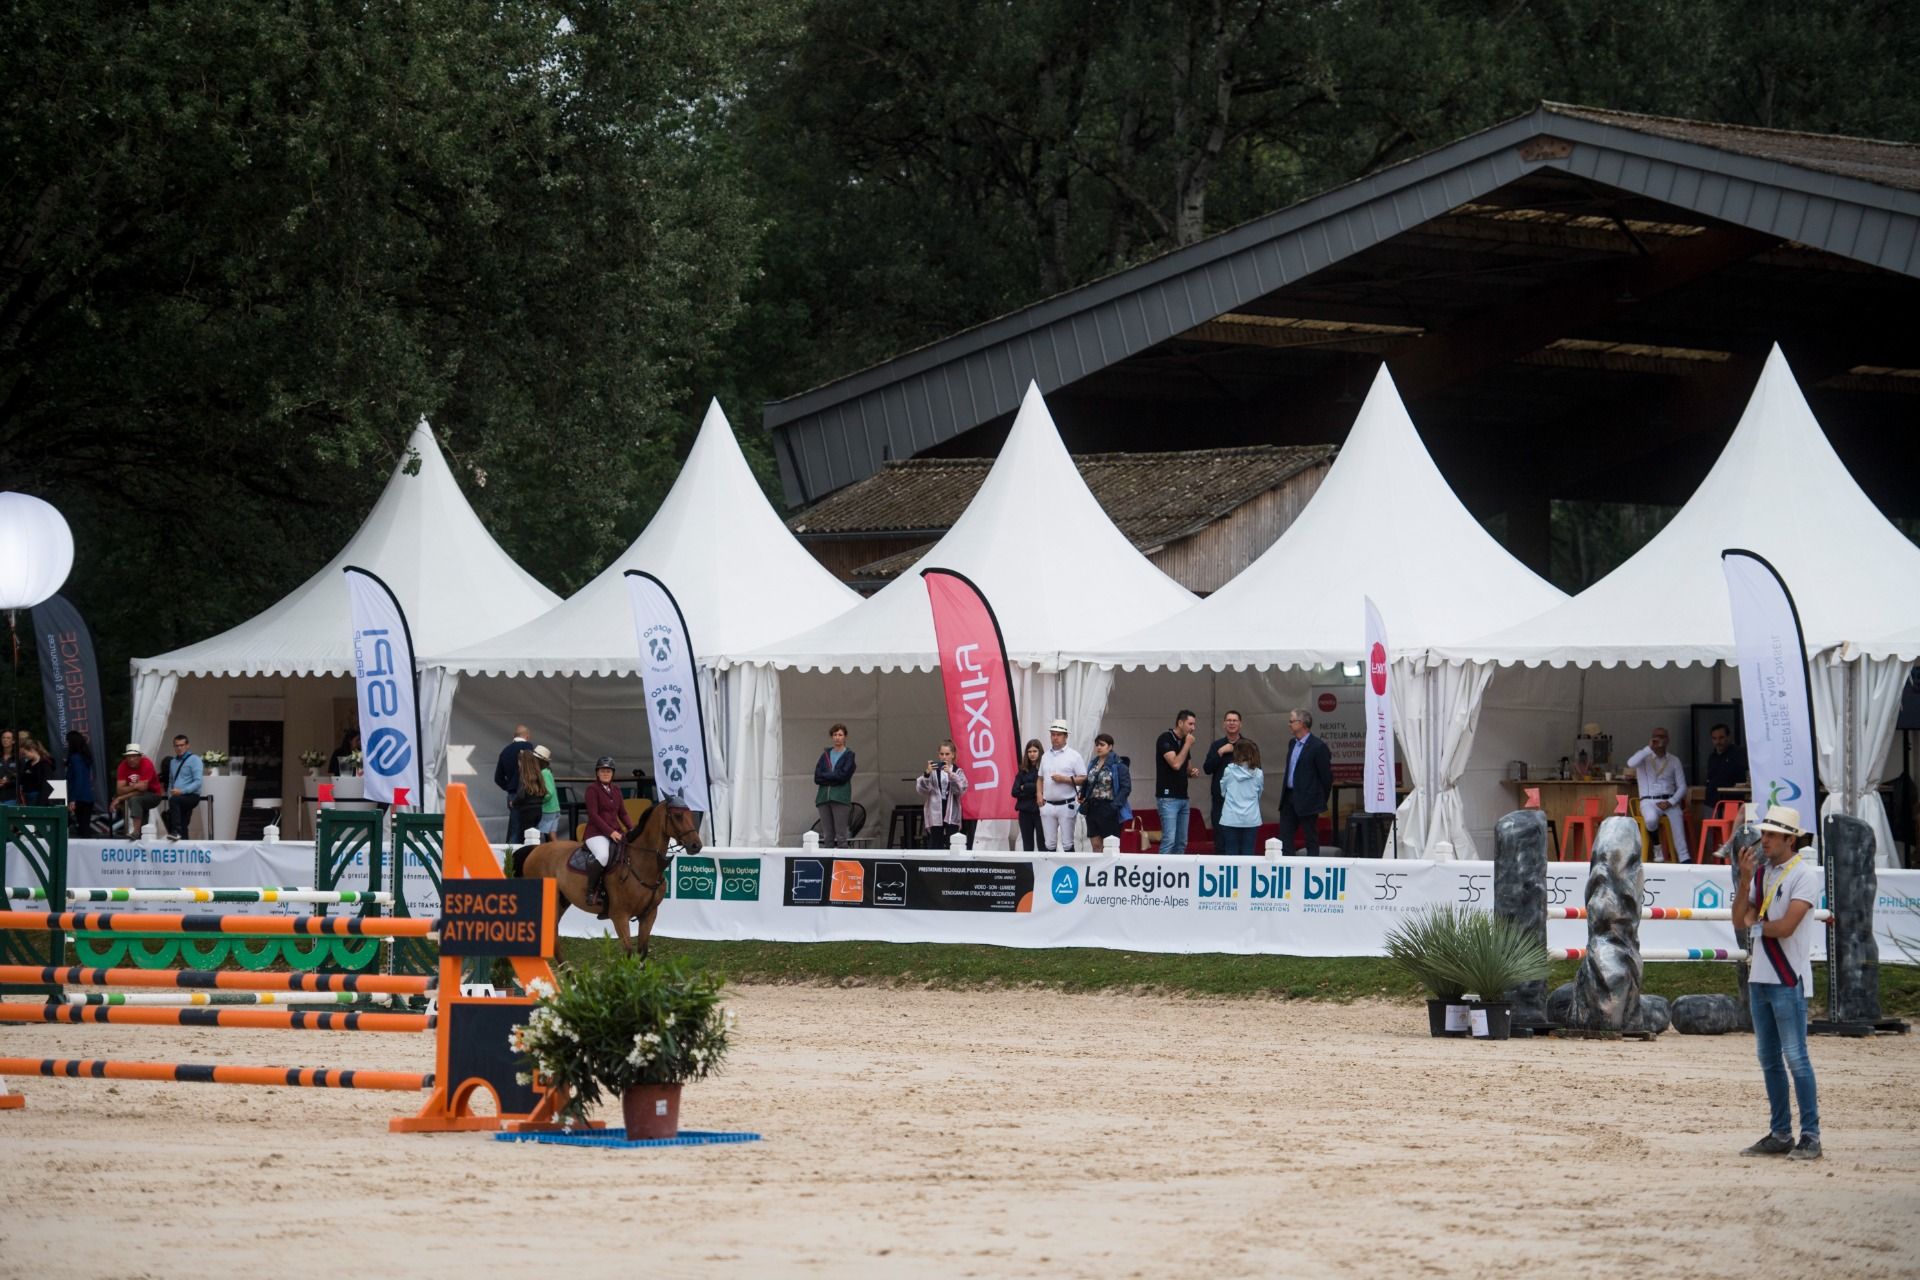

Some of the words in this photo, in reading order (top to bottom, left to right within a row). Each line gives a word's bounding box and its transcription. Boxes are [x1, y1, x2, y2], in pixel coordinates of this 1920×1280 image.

[101, 848, 147, 863] GROUPE
[151, 849, 211, 864] MEETINGS
[692, 866, 715, 874] Optique
[736, 867, 759, 875] Optique
[1085, 865, 1109, 888] La
[1114, 865, 1190, 893] Région
[445, 894, 518, 915] ESPACES
[1083, 894, 1189, 908] Auvergne-Rhône-Alpes
[443, 921, 536, 943] ATYPIQUES
